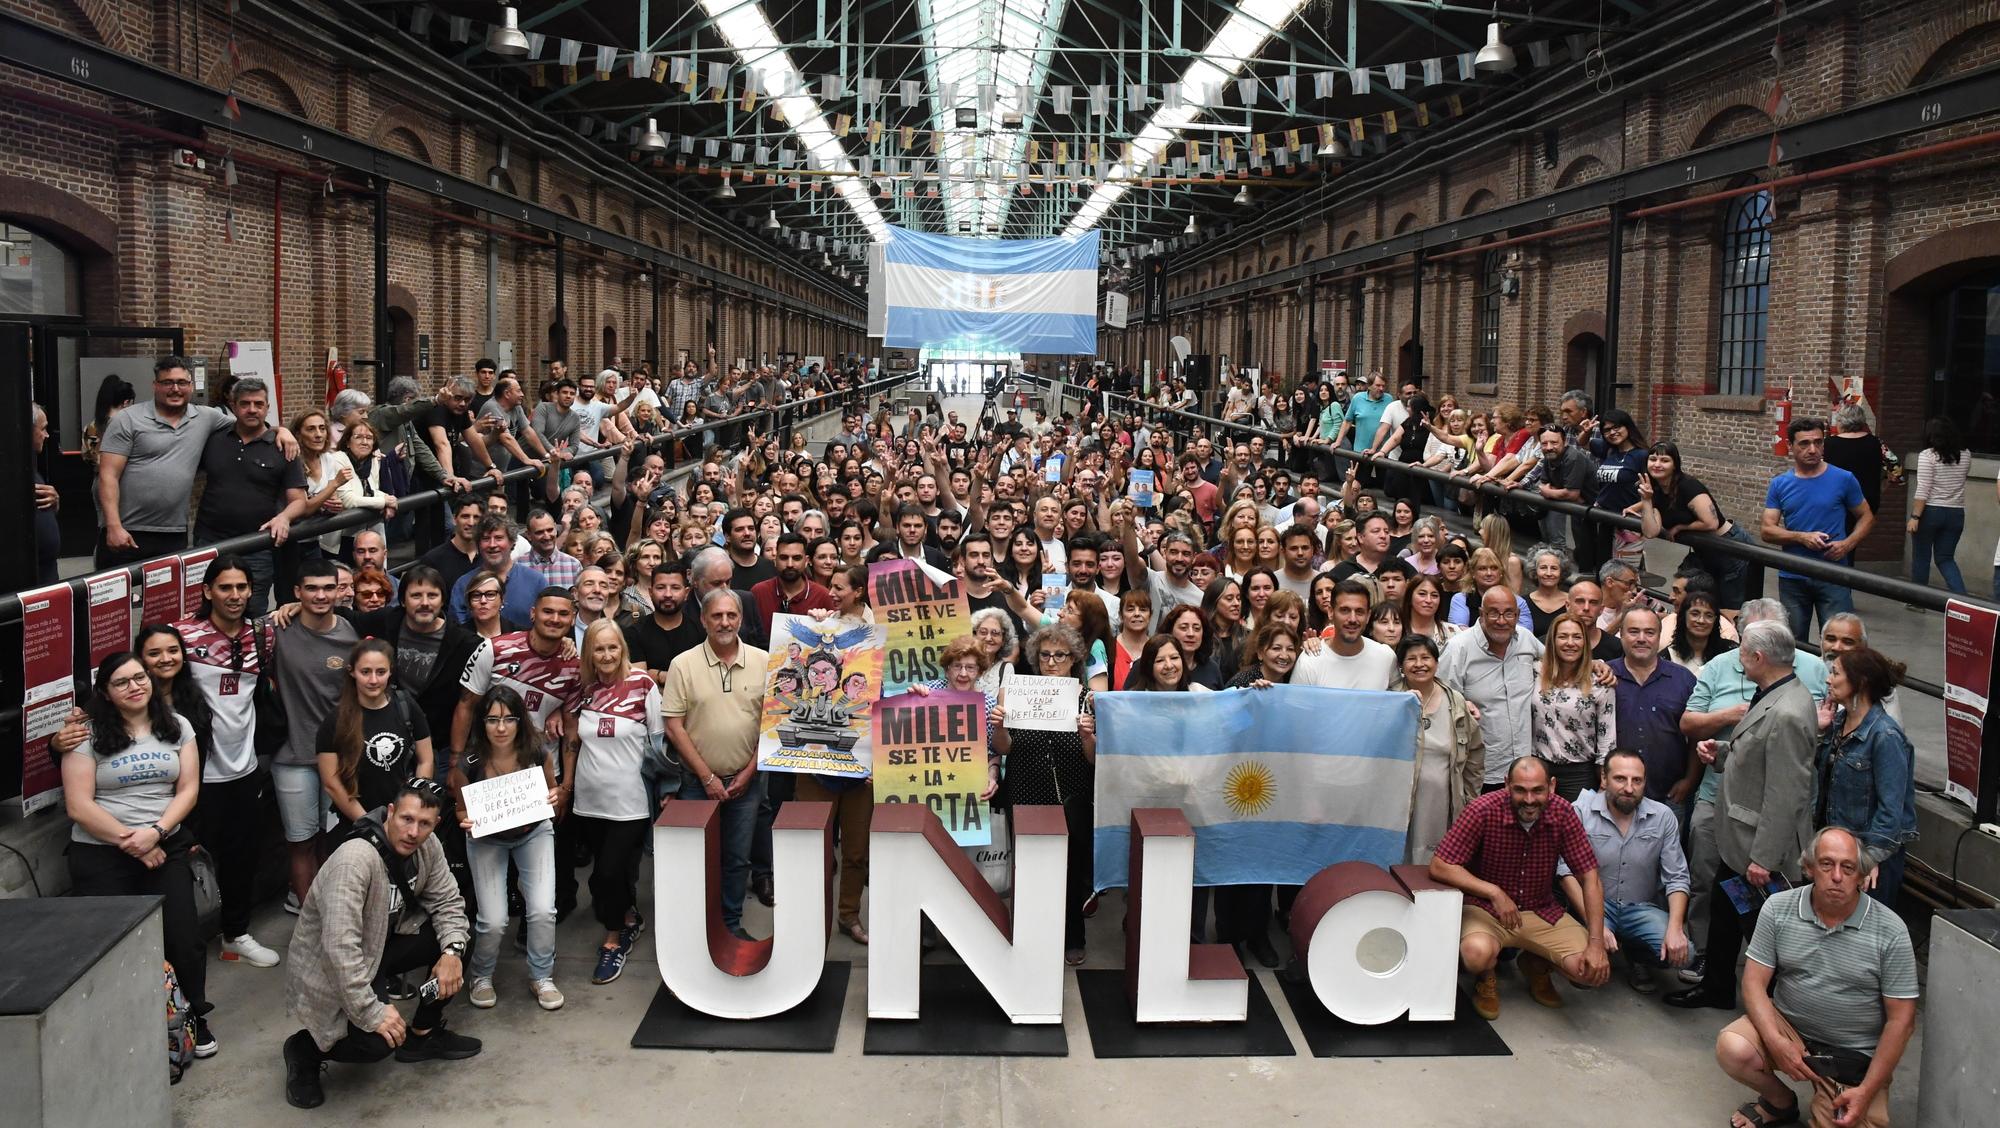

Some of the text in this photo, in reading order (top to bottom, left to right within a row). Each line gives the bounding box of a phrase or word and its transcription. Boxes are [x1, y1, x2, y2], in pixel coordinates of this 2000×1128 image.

[71, 57, 89, 78] 68
[1921, 103, 1941, 122] 69
[887, 603, 956, 623] SE TE VE
[920, 625, 935, 640] LA
[1009, 677, 1019, 686] LA
[527, 694, 539, 702] UN
[1027, 697, 1054, 705] VENDE
[881, 704, 978, 745] MILEI
[111, 752, 171, 769] STRONG
[791, 750, 808, 758] VEO
[820, 751, 855, 762] FUTURO
[888, 746, 972, 765] SE TE VE
[132, 763, 145, 772] AS
[764, 757, 865, 773] REPETIR EL PASADO
[118, 770, 169, 784] WOMAN
[924, 769, 943, 786] LA
[485, 793, 527, 812] DERECHO
[475, 799, 542, 828] NO UN PRODUCTO
